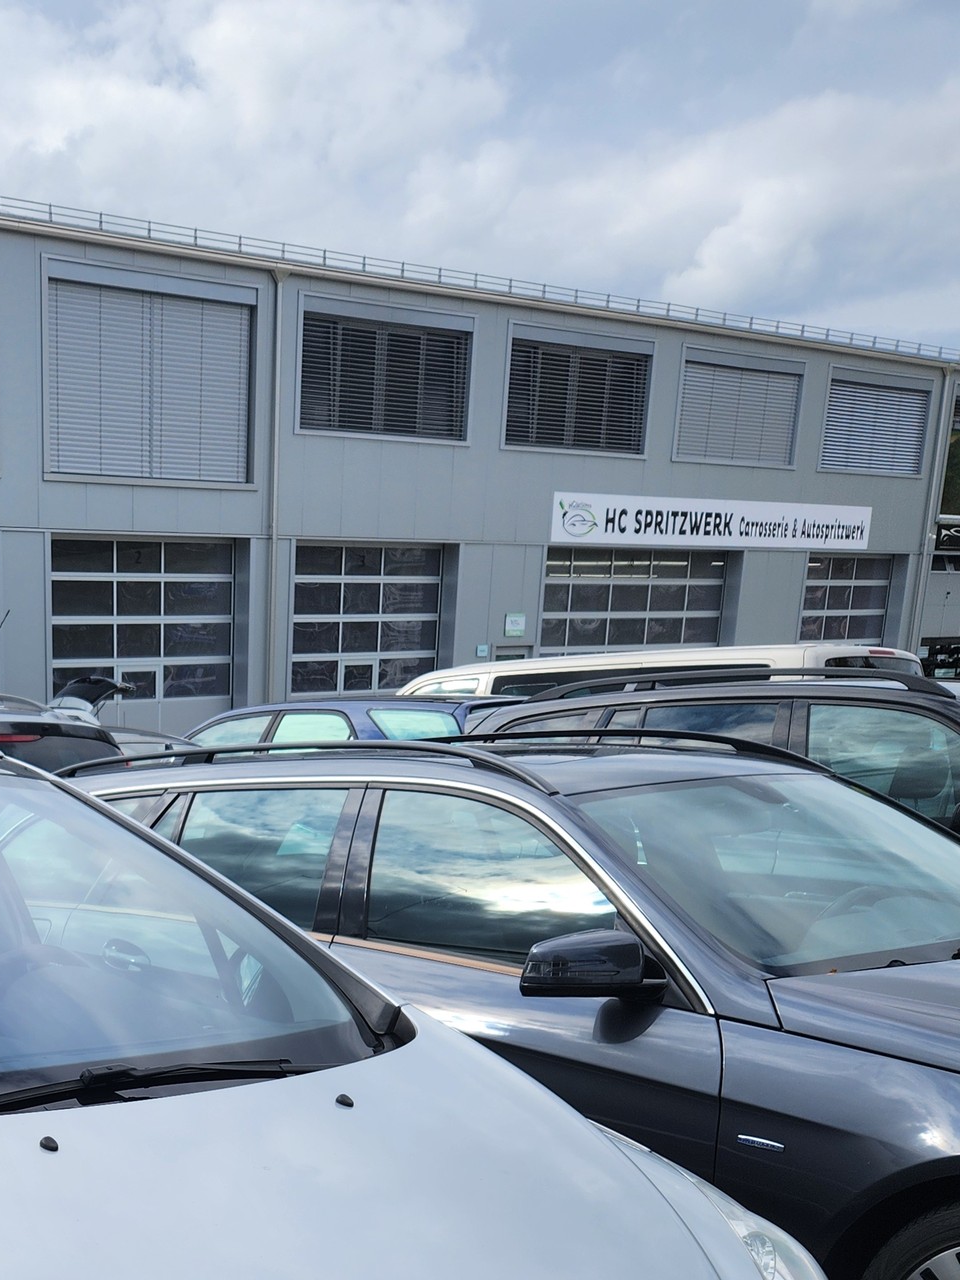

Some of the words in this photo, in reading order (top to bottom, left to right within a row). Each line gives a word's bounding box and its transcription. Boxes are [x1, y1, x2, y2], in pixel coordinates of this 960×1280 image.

[604, 507, 628, 534] HC
[633, 508, 734, 537] SPRITZWERK
[739, 515, 789, 539] Carrosserie
[791, 518, 798, 539] &
[800, 518, 865, 544] Autospritzwerk
[134, 550, 142, 564] 2
